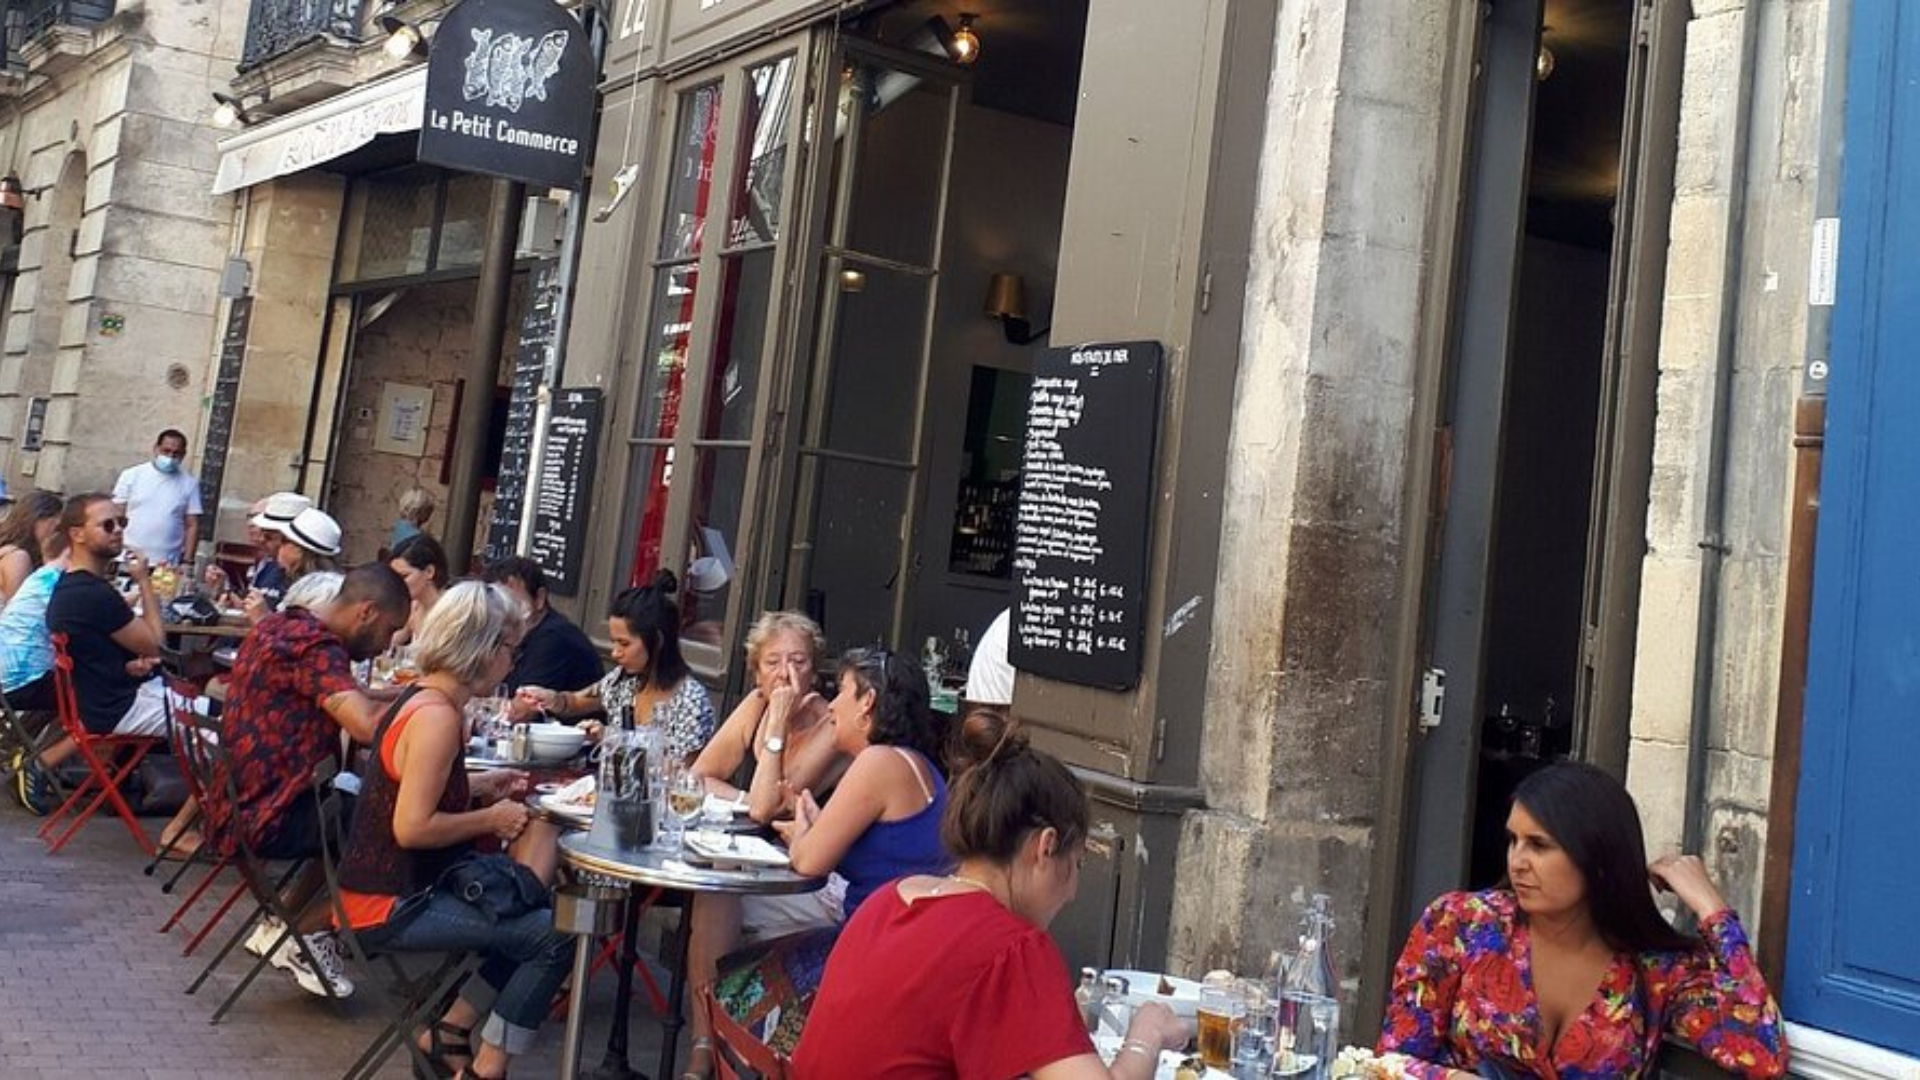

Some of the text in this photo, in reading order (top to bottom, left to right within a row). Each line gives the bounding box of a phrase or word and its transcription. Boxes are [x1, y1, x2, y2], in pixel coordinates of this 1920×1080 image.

[431, 109, 578, 154] Le Petit Commerce
